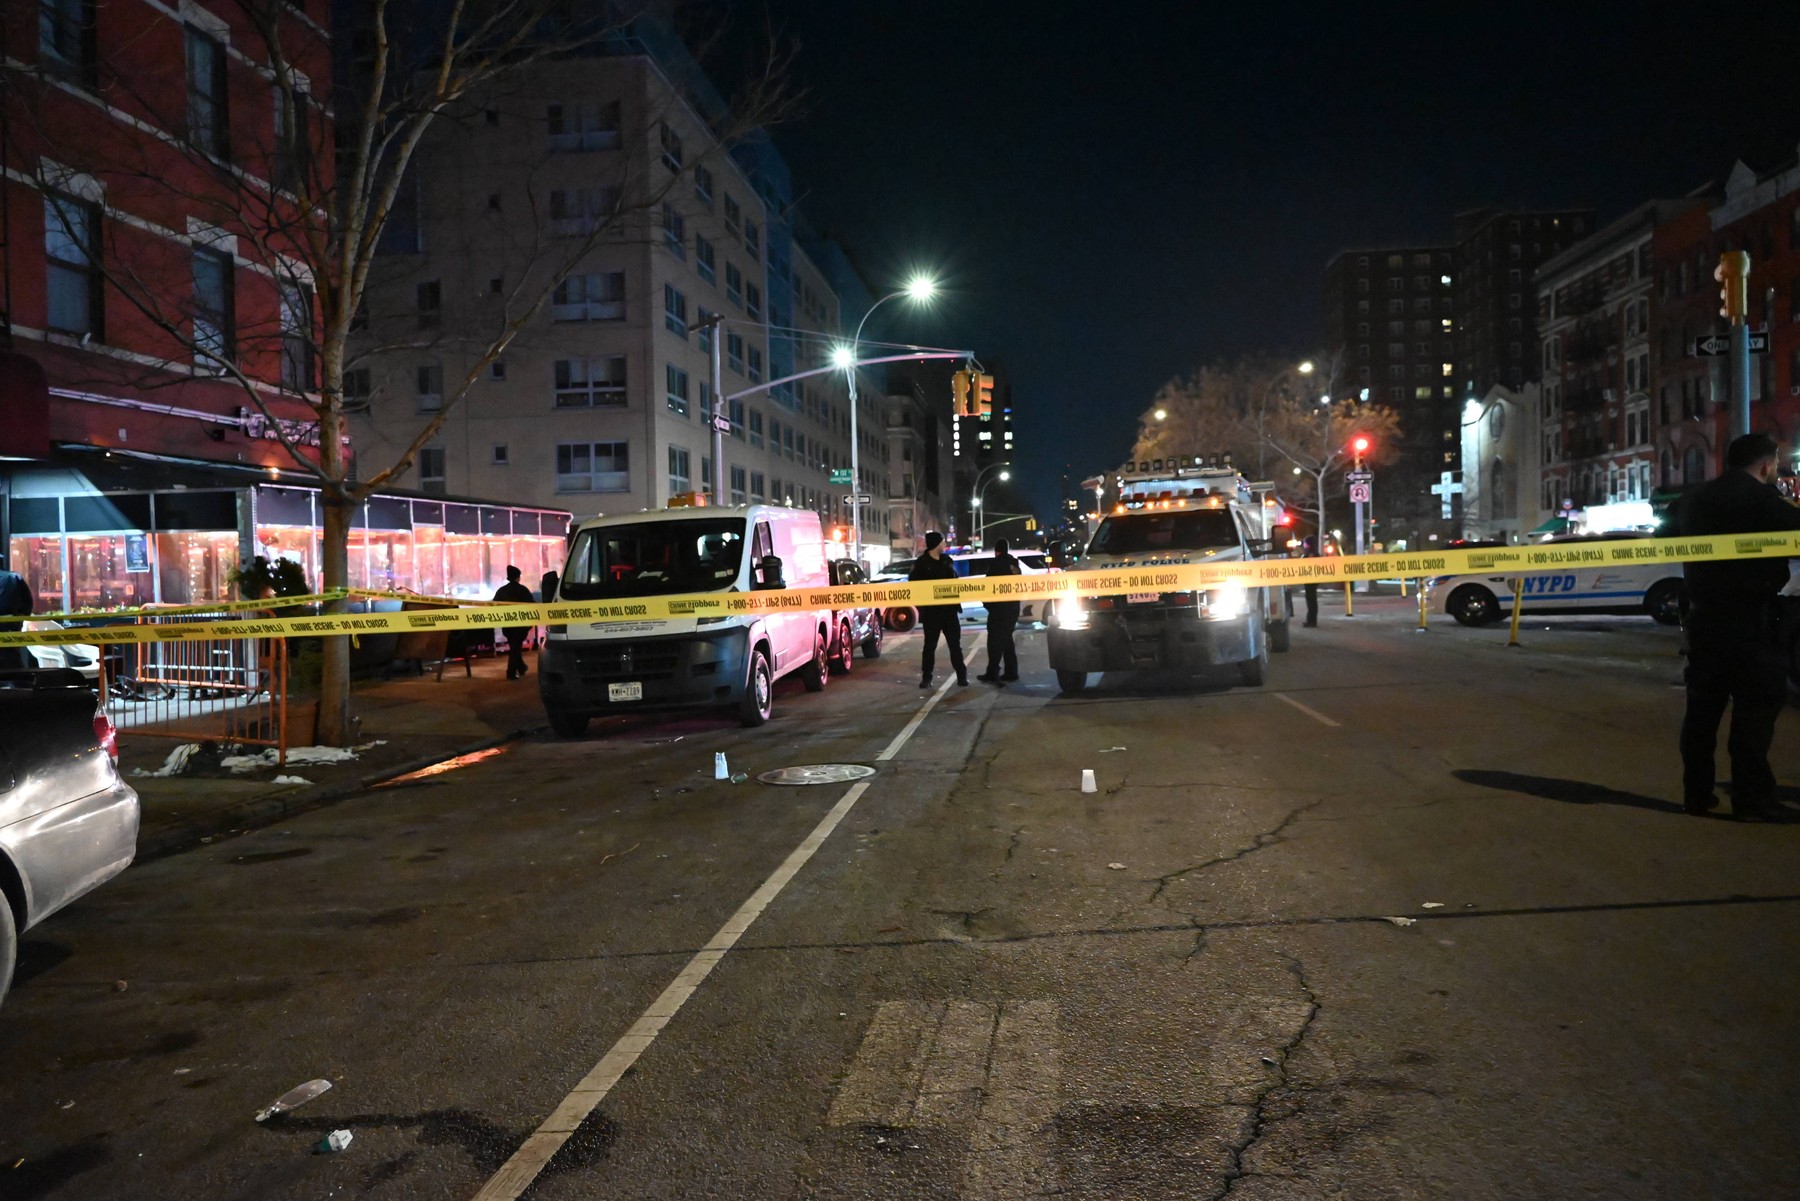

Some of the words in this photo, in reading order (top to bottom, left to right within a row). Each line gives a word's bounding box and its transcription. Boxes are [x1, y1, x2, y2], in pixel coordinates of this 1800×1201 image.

[1707, 340, 1727, 351] ONE
[1100, 561, 1136, 569] NYPD
[1141, 558, 1190, 567] POLICE
[1522, 575, 1577, 593] NYPD
